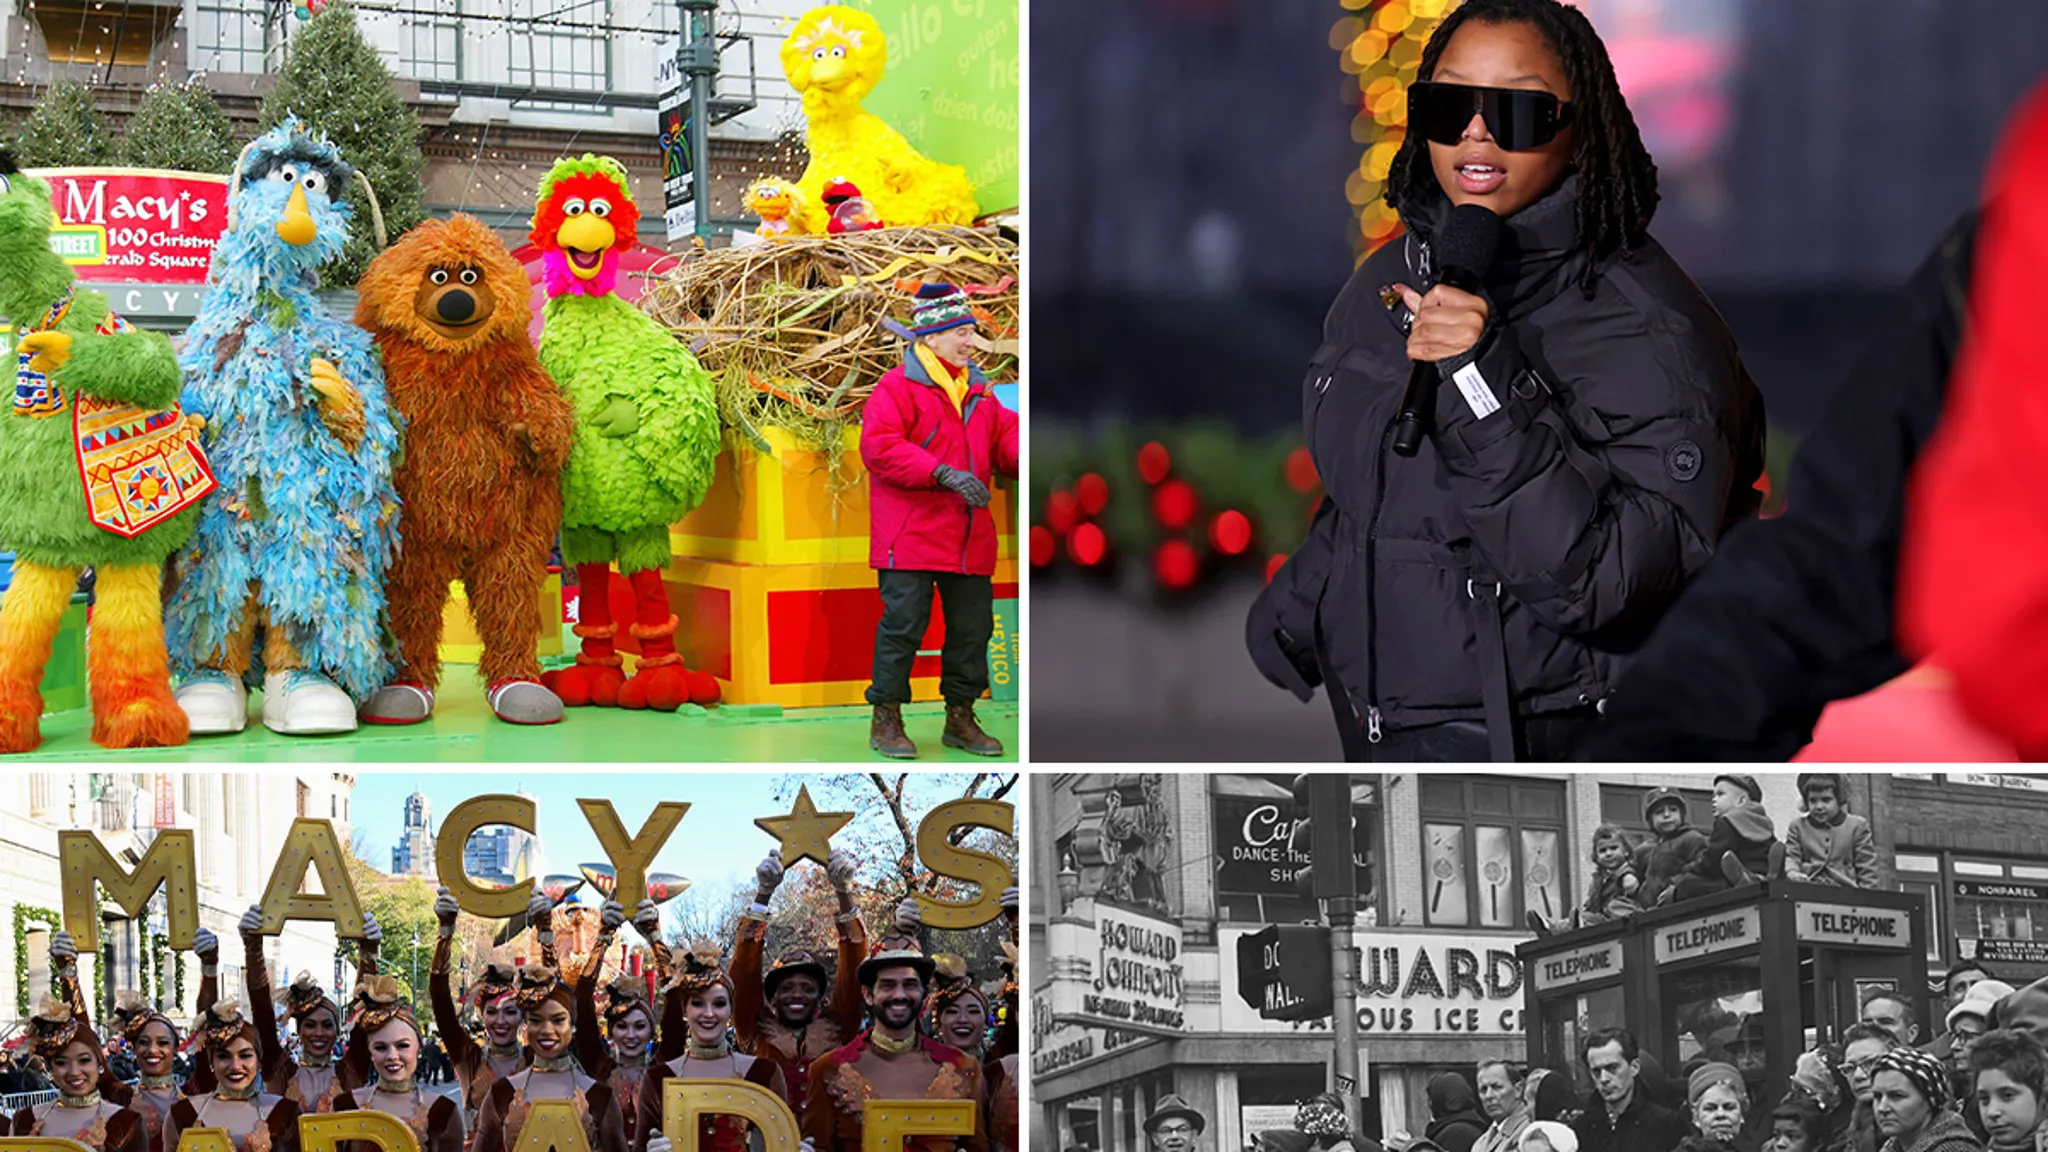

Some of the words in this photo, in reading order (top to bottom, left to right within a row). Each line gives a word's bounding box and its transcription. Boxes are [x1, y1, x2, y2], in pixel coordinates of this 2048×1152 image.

[885, 3, 943, 70] ello
[968, 146, 1017, 188] usto
[108, 227, 149, 247] 100
[103, 250, 145, 266] erald
[1978, 885, 2038, 898] NONPAREIL
[1666, 917, 1747, 954] TELEPHONE
[1810, 911, 1897, 938] TELEPHONE
[1101, 918, 1177, 963] HOWARD
[1354, 945, 1525, 1001] WARD
[1544, 950, 1611, 982] TELEPHONE
[1264, 981, 1304, 1011] WAL
[1435, 1008, 1479, 1031] ICE
